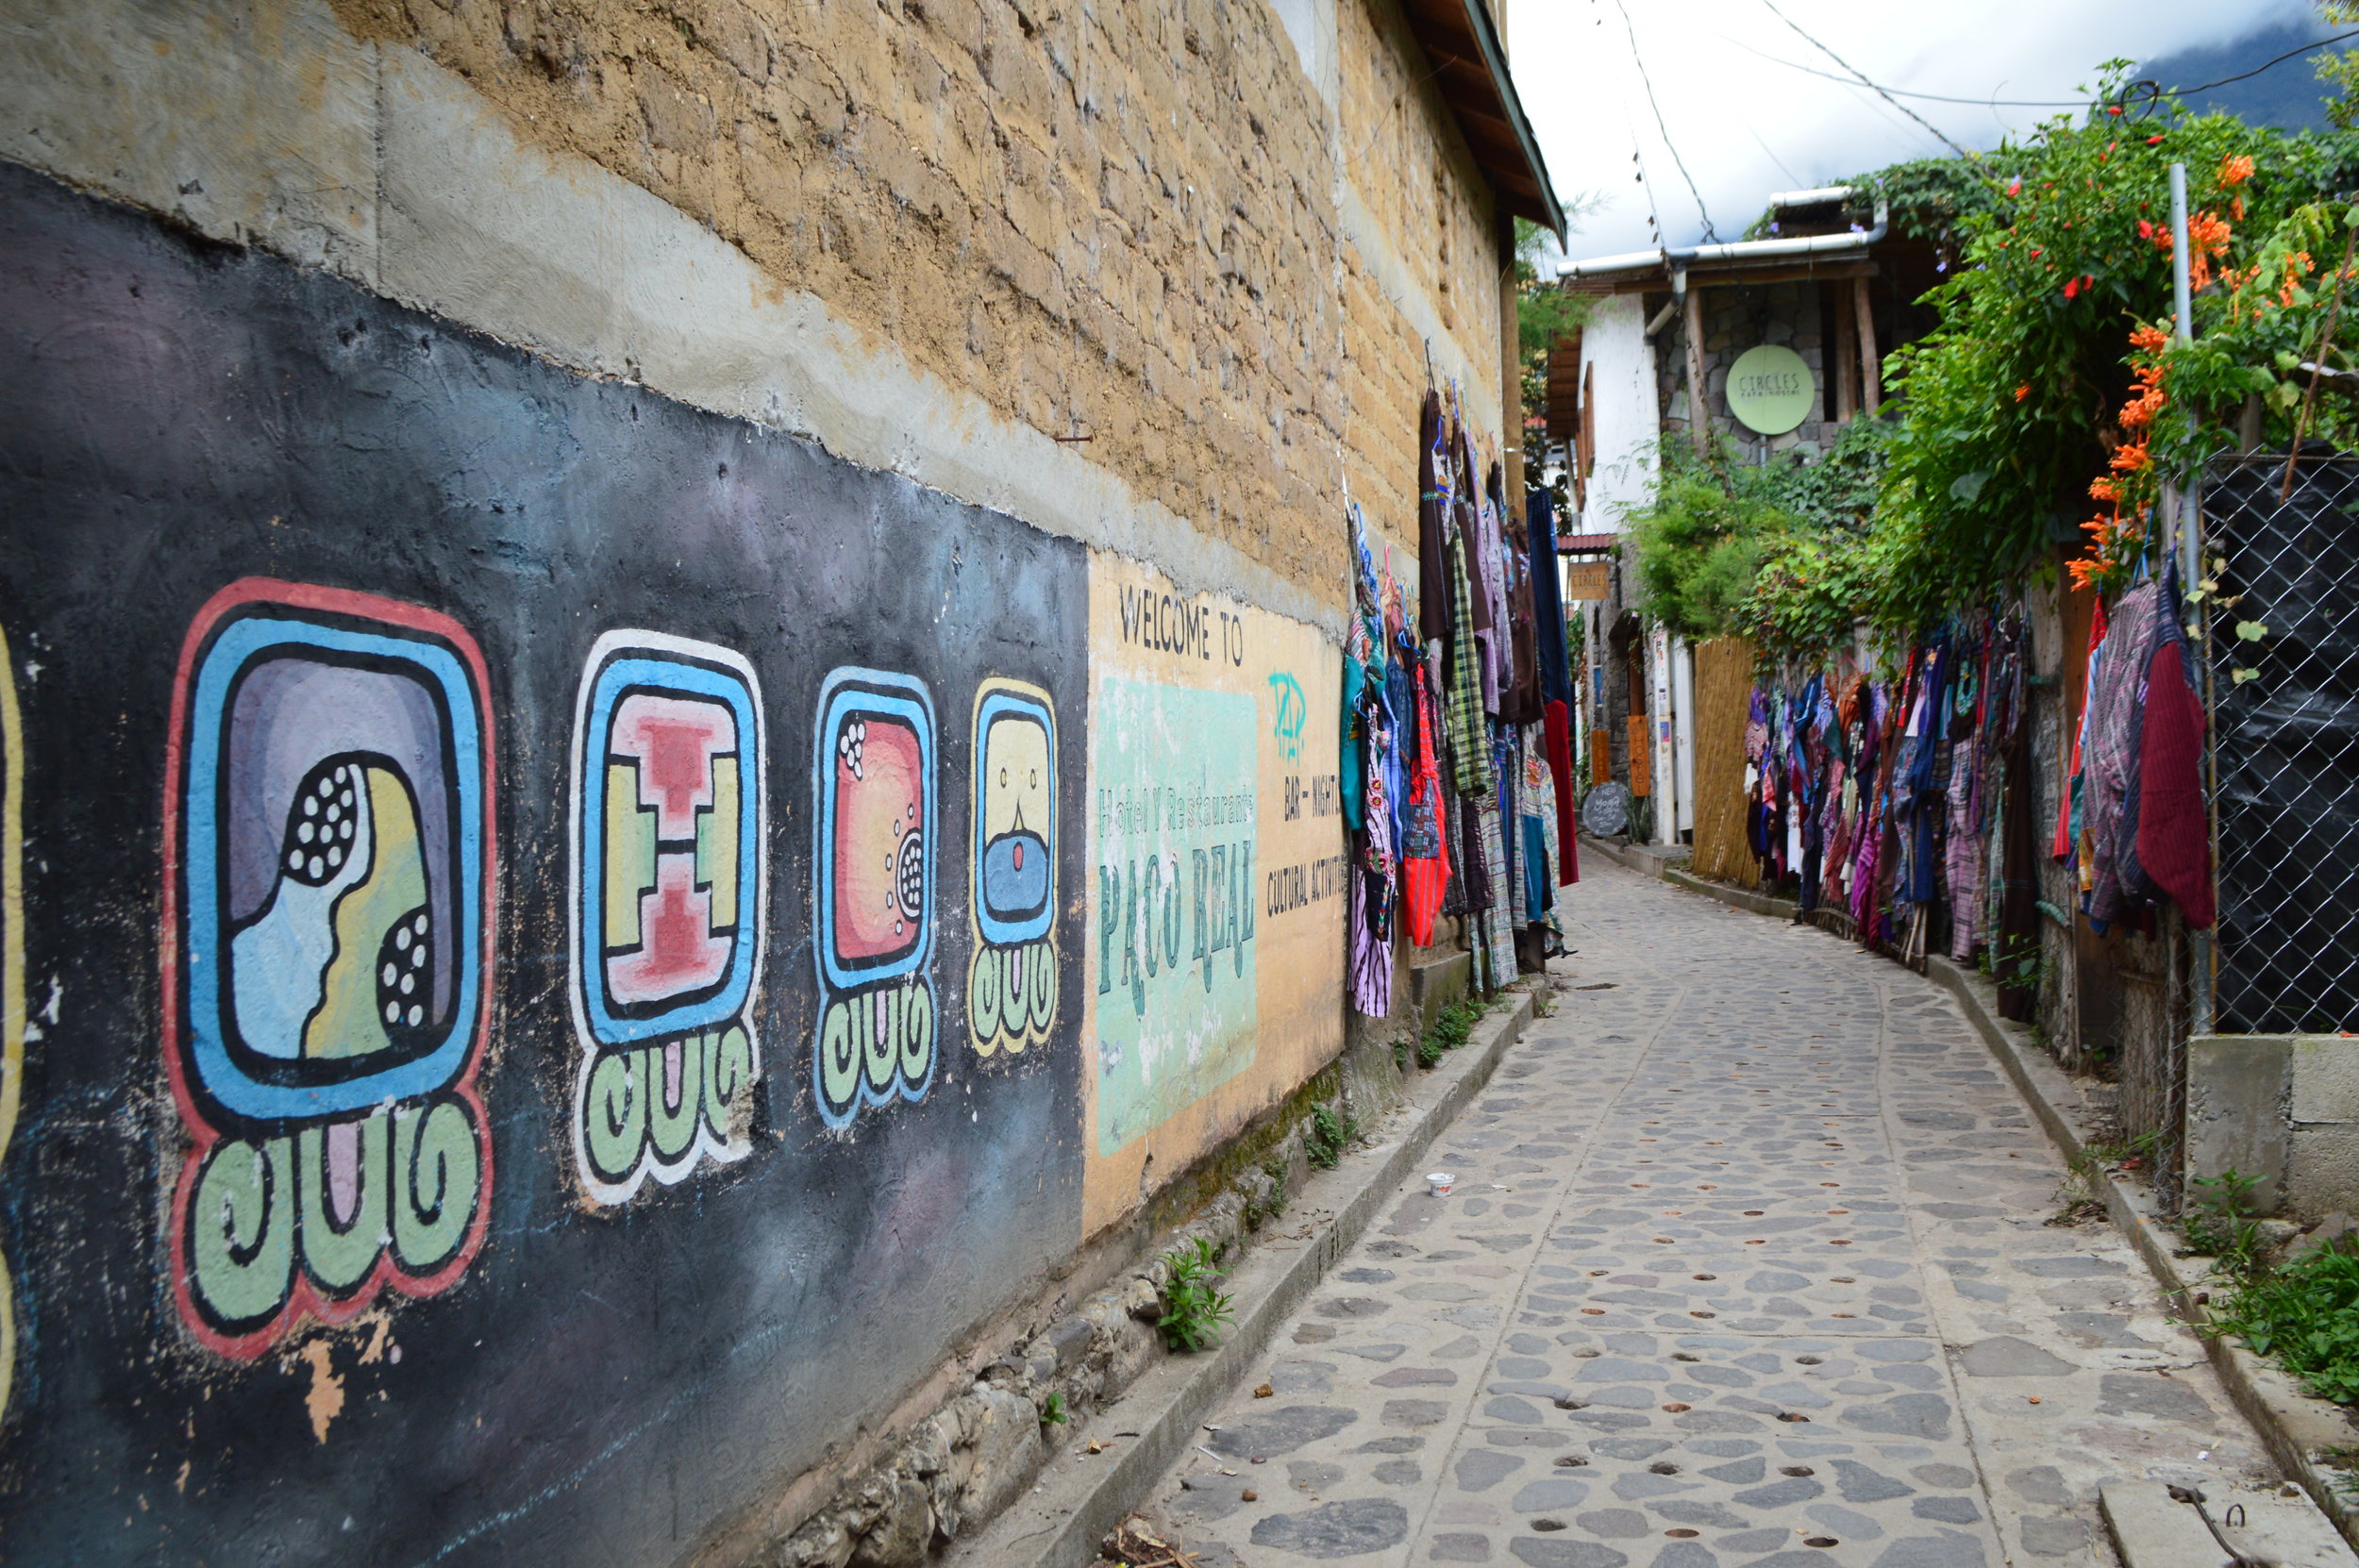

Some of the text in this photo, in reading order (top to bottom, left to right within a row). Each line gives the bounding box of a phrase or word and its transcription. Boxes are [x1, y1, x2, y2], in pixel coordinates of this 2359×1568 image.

[1739, 373, 1799, 392] CIRCLES
[1119, 581, 1243, 667] WELCOME TO
[1099, 788, 1147, 838] Hotel
[1167, 785, 1253, 831] Restaurante
[1284, 775, 1300, 822] BAR
[1313, 774, 1341, 818] NIGHTL
[1267, 863, 1309, 918] CULTURAL
[1099, 841, 1254, 1022] PACO REAL
